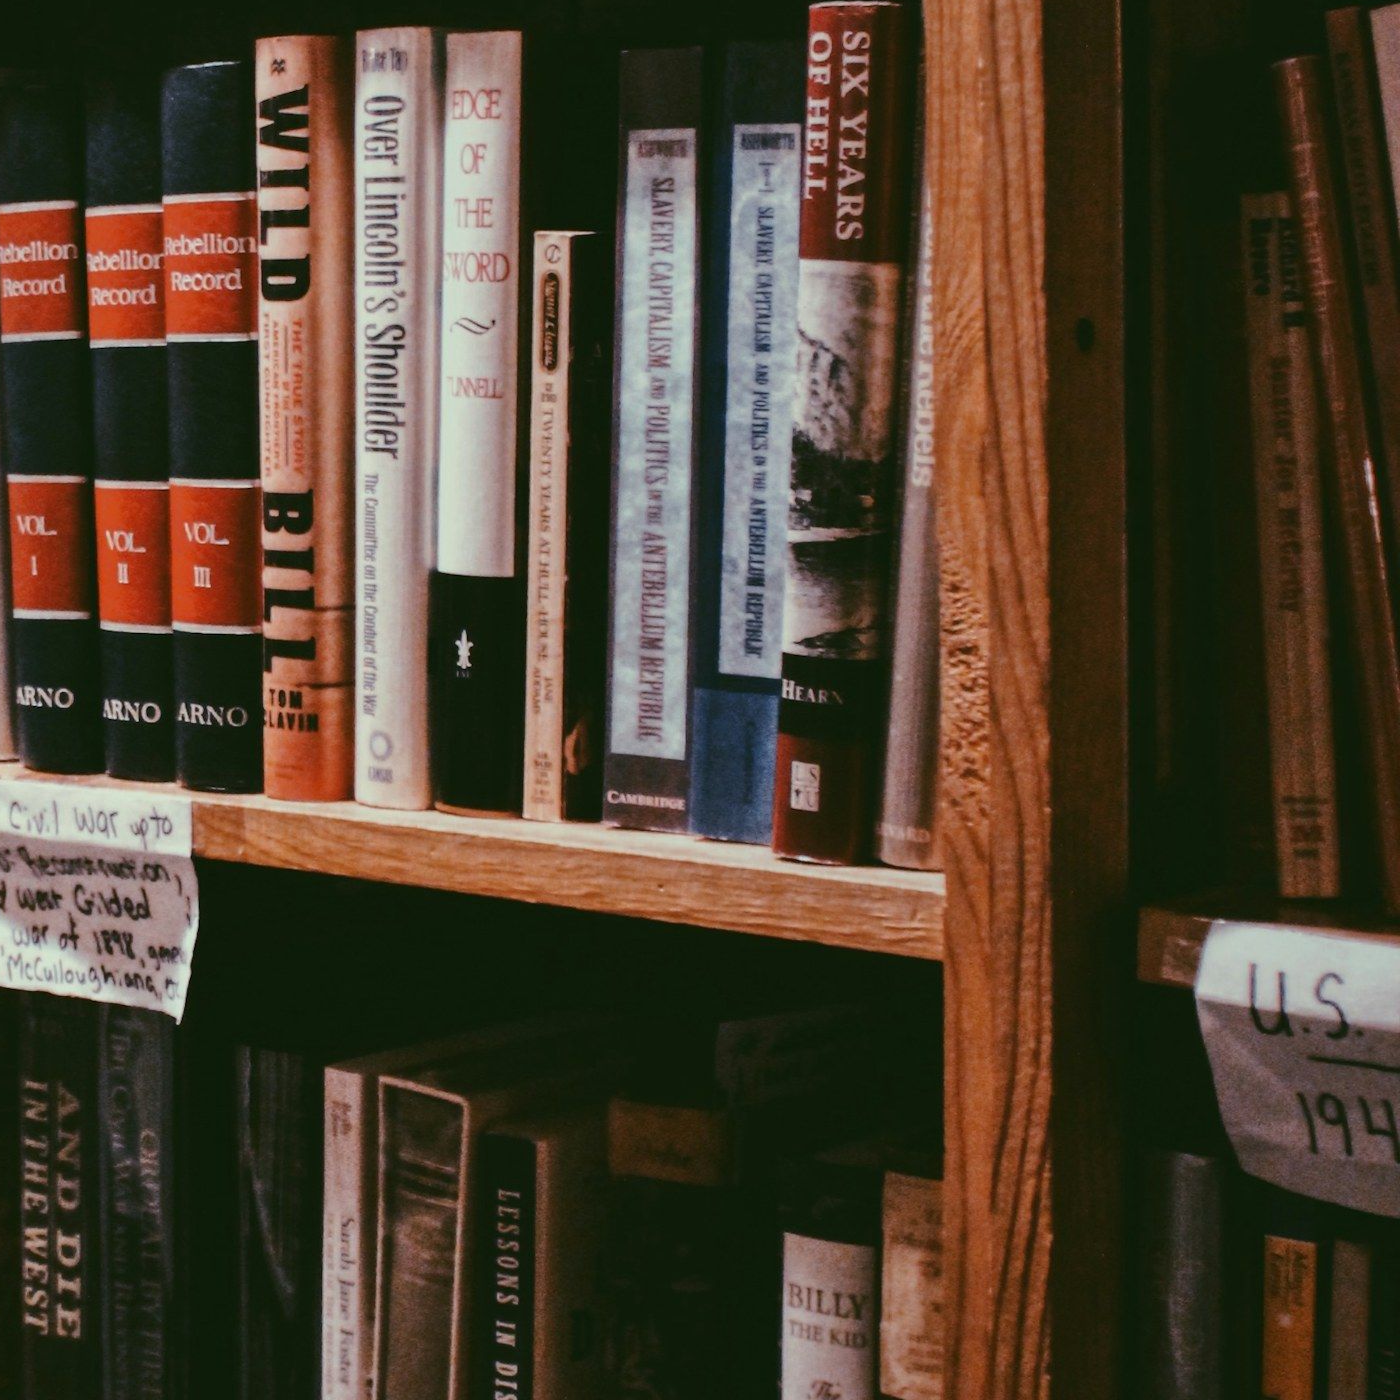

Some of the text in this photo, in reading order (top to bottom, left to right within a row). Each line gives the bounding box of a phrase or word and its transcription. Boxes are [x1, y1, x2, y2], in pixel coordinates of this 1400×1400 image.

[452, 89, 503, 120] EDGE
[804, 30, 833, 201] OF HELL
[460, 143, 487, 175] OF
[836, 30, 872, 241] SIX YEARS
[454, 198, 493, 229] THE
[4, 275, 67, 298] Record
[164, 233, 257, 292] Rebellion Record
[362, 95, 406, 461] Over Lincoln's Shoulder
[91, 285, 157, 306] Record
[259, 84, 316, 673] WILD BILL
[539, 411, 554, 534] TWENTY YEARS
[743, 390, 772, 658] POLITICS ANTEBELLUM REPUBLIC
[363, 473, 379, 717] The Committee Conduct War
[638, 404, 671, 743] POLITICS ANTEBELLUM REPUBLIC
[16, 686, 75, 709] ARNO
[102, 699, 162, 724] ARNO
[177, 702, 249, 727] ARNO
[269, 688, 303, 710] TOM
[1249, 962, 1365, 1040] U.S.
[23, 1135, 50, 1337] THE WEST
[55, 1081, 82, 1340] AND DIE
[496, 1188, 521, 1306] LESSONS
[787, 1281, 869, 1321] BILLY
[495, 1320, 517, 1348] IN
[788, 1318, 867, 1350] THE KID
